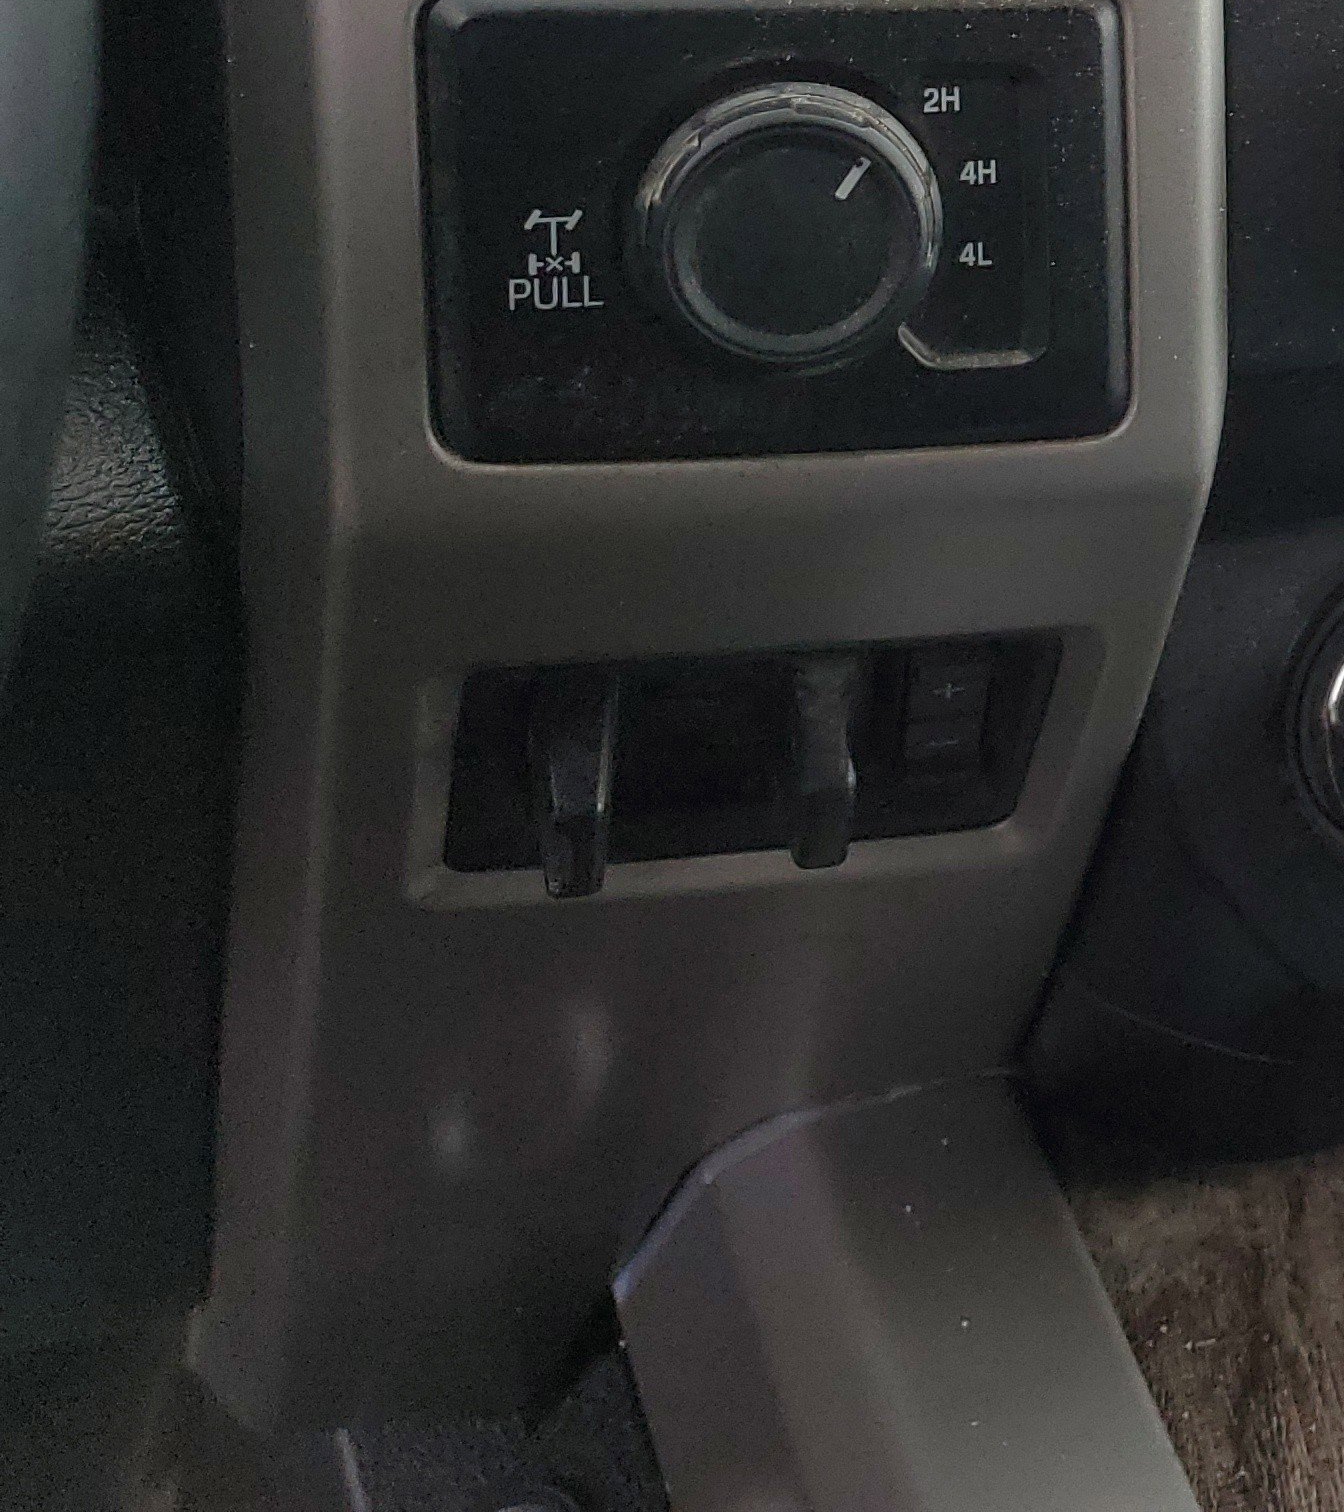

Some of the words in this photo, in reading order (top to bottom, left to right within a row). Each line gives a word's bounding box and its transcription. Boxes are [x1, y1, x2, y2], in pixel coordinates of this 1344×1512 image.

[923, 88, 961, 114] 2H
[960, 159, 998, 186] 4H
[959, 242, 993, 268] 4L
[508, 277, 605, 311] PULL
